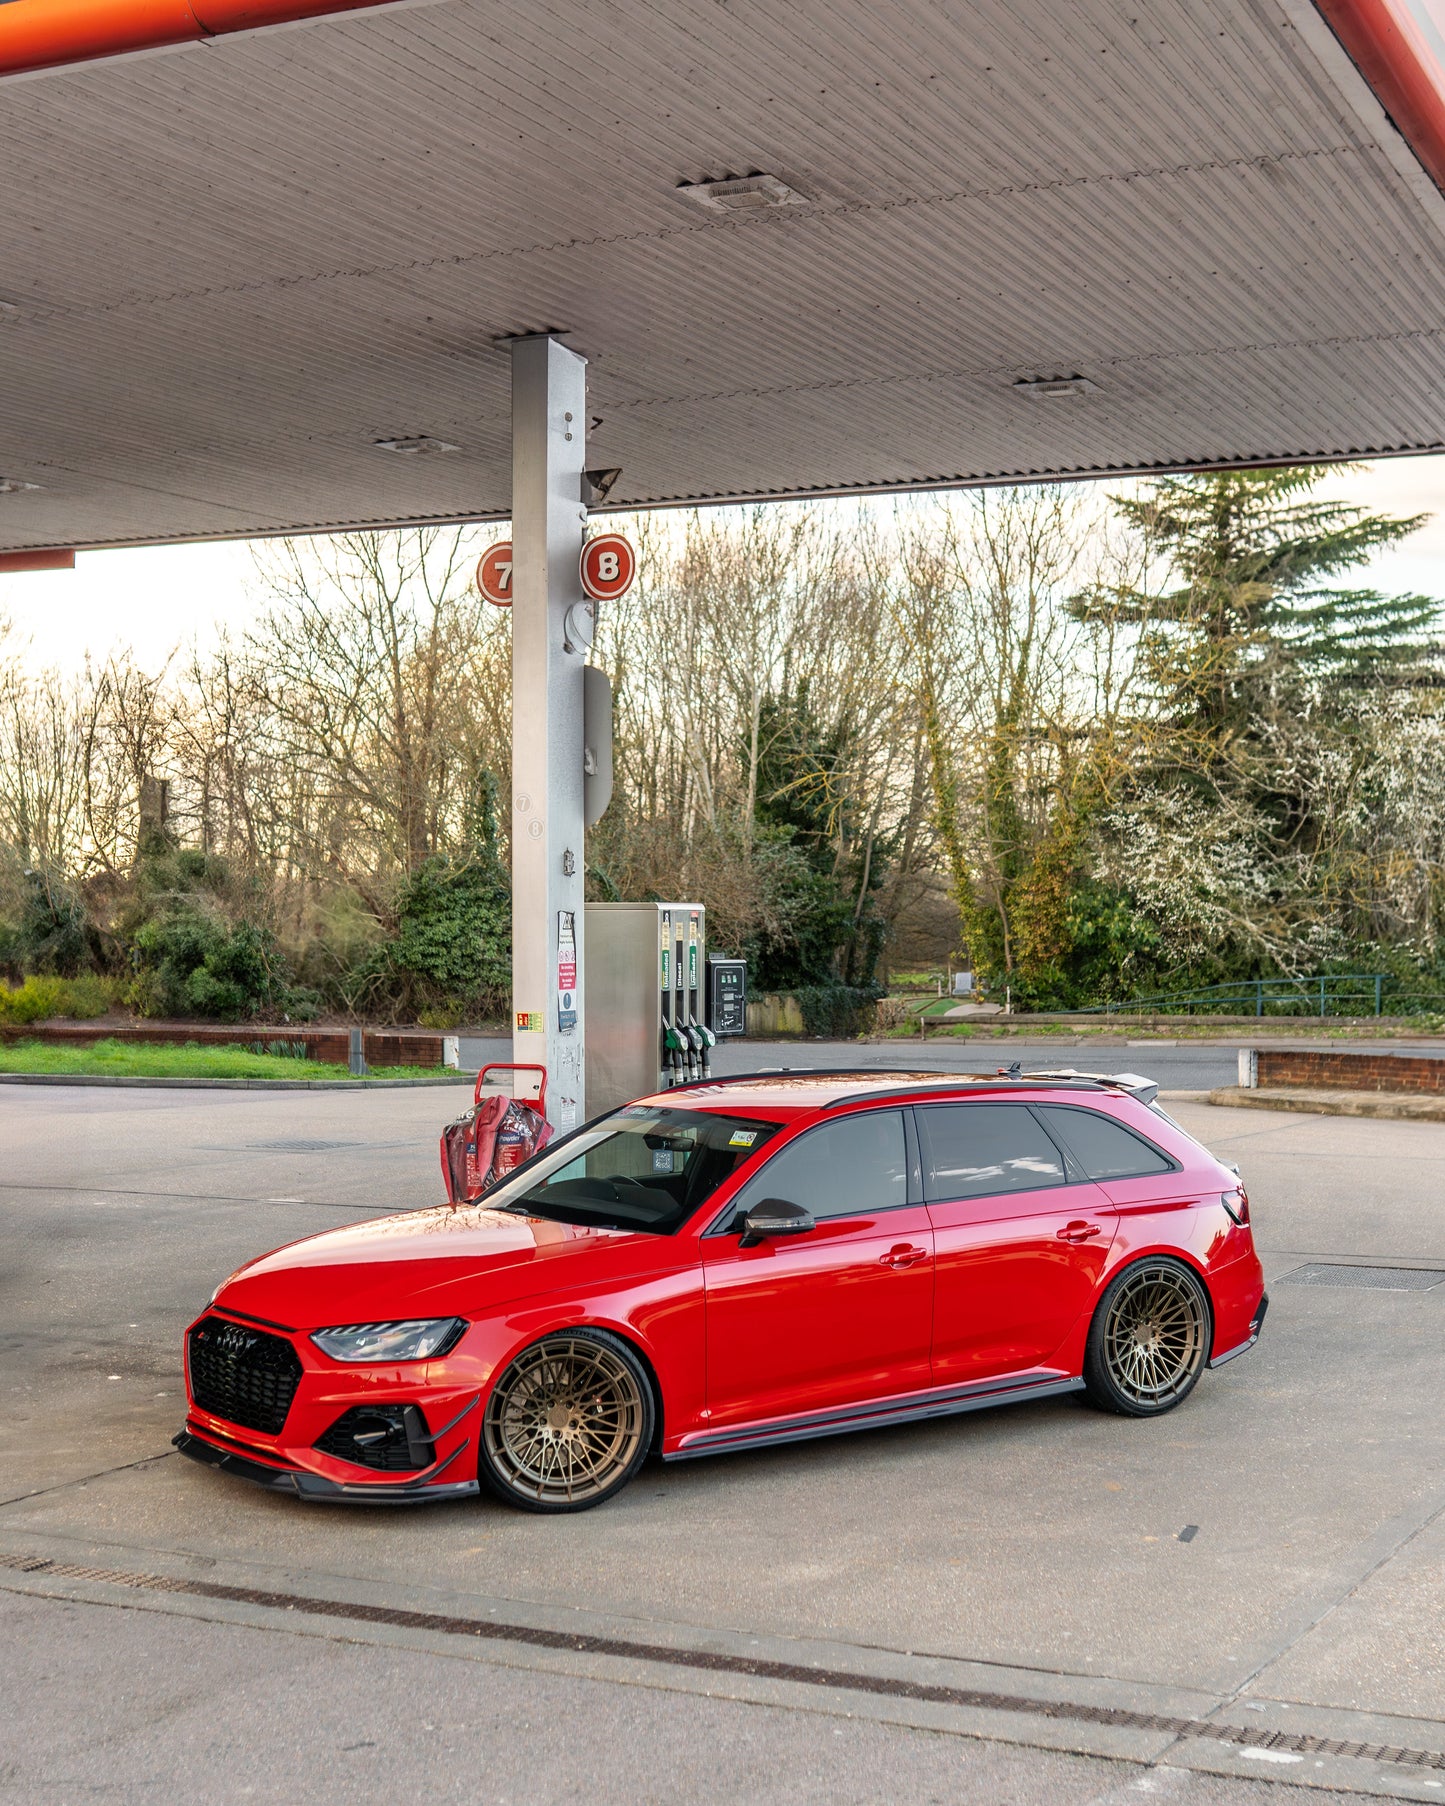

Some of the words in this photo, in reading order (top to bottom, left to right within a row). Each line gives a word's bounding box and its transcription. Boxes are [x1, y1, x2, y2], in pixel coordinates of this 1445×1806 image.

[494, 561, 512, 590] 7
[598, 552, 620, 581] 8
[532, 822, 539, 836] 8
